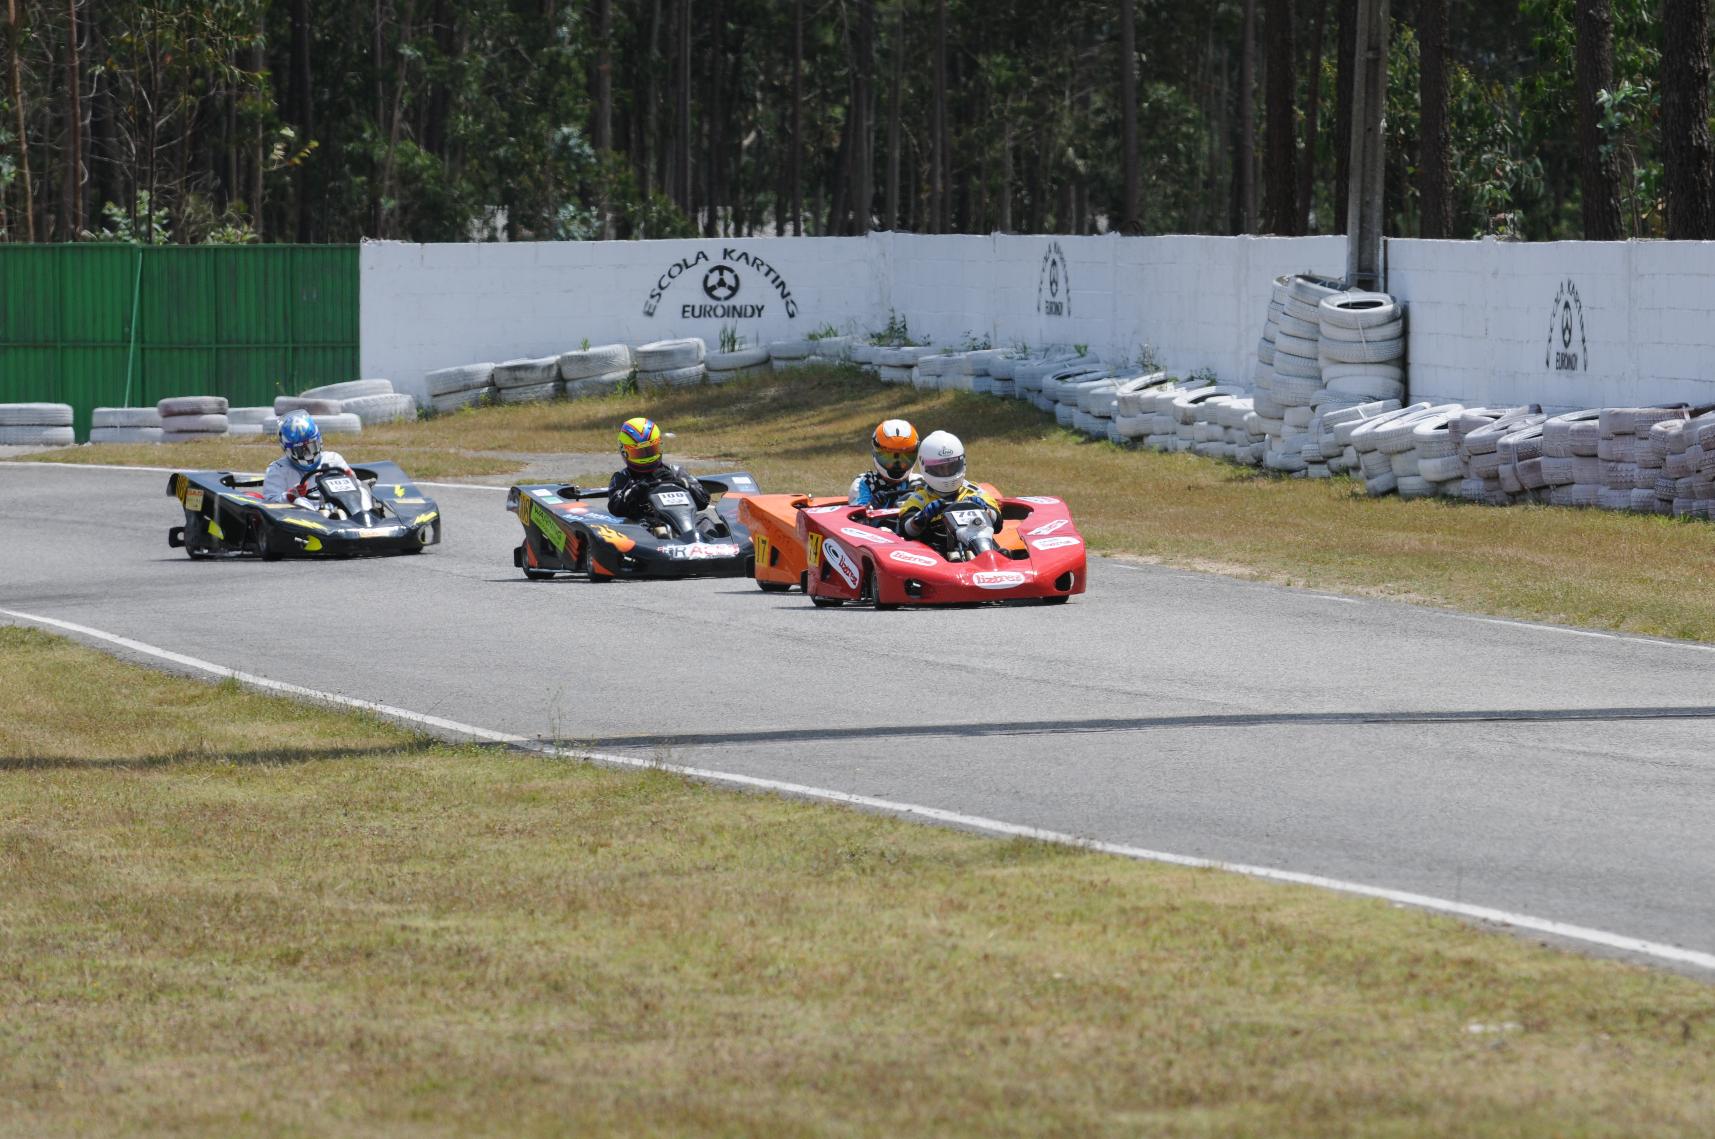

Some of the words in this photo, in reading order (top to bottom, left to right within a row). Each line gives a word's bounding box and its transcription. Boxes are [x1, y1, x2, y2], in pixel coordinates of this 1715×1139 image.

[643, 251, 709, 317] ESCOLA
[723, 248, 799, 319] KARTING
[681, 304, 765, 318] EUROINDY
[757, 536, 767, 564] 17
